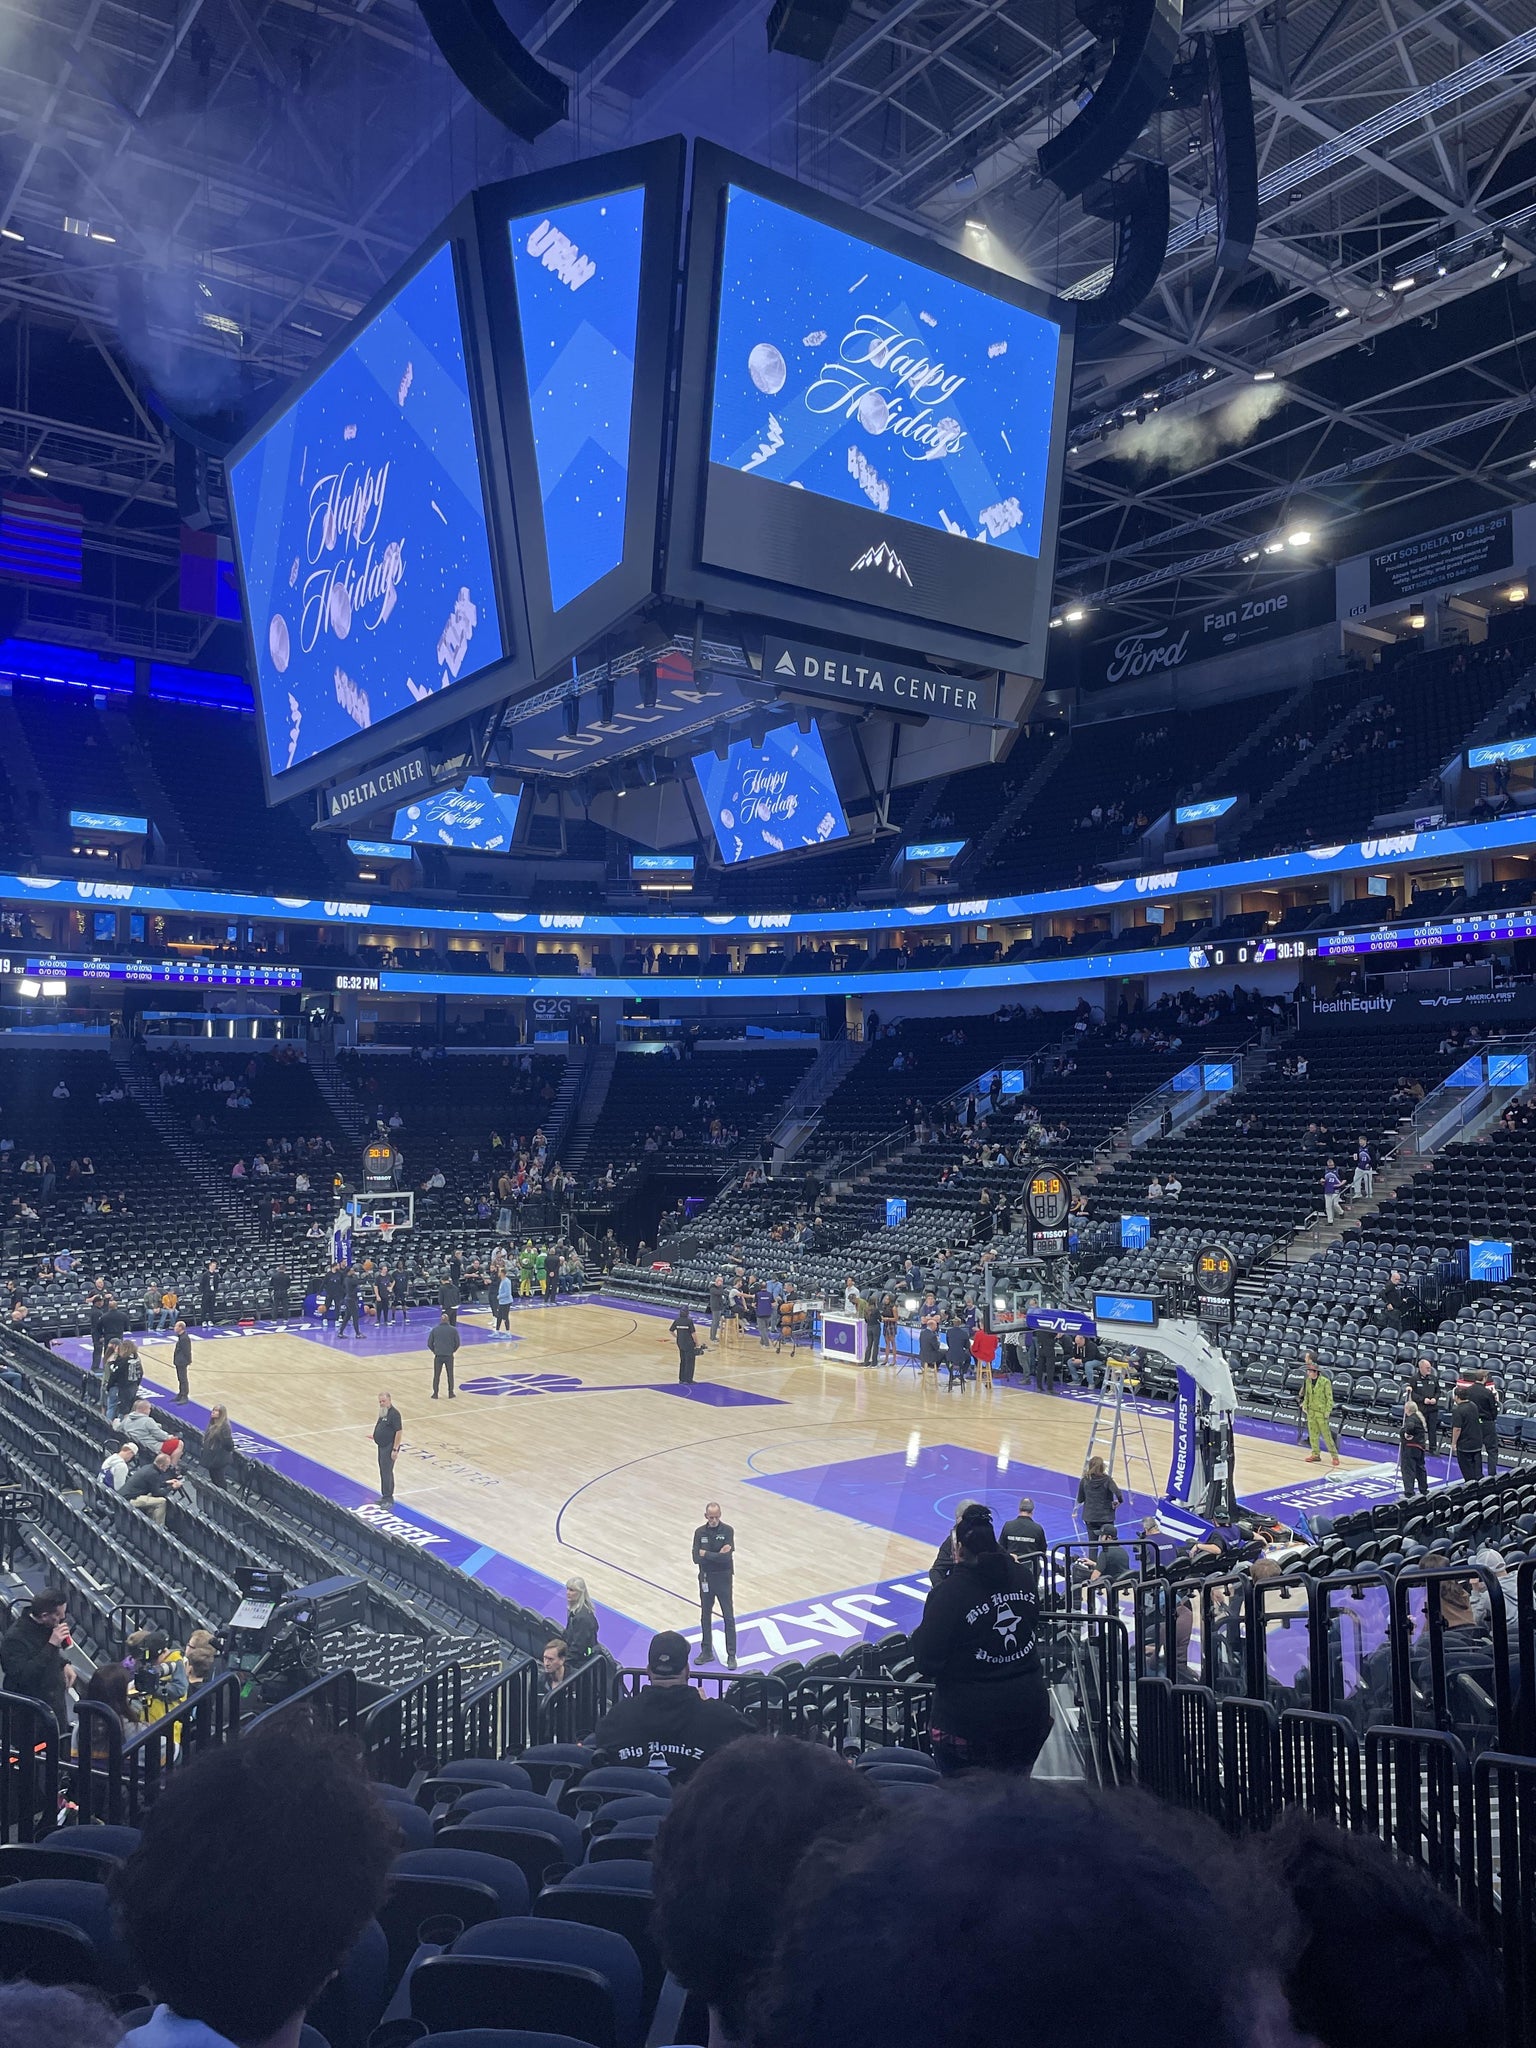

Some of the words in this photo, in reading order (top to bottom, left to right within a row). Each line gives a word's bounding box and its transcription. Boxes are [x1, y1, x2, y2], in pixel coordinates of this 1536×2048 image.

[840, 314, 966, 405] Happy
[805, 363, 968, 461] Hidays
[307, 461, 390, 564] Happy
[1375, 552, 1398, 566] TEXT
[1399, 545, 1418, 559] SOS
[1420, 535, 1449, 552] DELTA
[1451, 531, 1465, 542] TO
[300, 538, 406, 653] Hlidays
[1401, 584, 1416, 593] TEXT
[1203, 611, 1237, 633] Fan
[1241, 594, 1288, 622] Zone
[1106, 627, 1190, 682] Ford
[805, 656, 884, 692] DELTA
[893, 677, 978, 711] CENTER
[341, 780, 378, 810] DELTA
[378, 760, 424, 793] CENTER
[742, 768, 788, 796] Happy
[438, 792, 485, 812] Happy
[740, 794, 798, 824] Hidays
[425, 806, 485, 830] Hidays
[1427, 926, 1442, 935] (0%)
[1427, 936, 1442, 945] (0%)
[1216, 949, 1224, 965] 0
[1239, 947, 1247, 963] 0
[1278, 941, 1304, 959] 30:19
[1306, 948, 1317, 956] 1ST
[336, 975, 361, 989] 06:32
[363, 977, 378, 990] PM
[533, 998, 571, 1013] G2G
[1312, 997, 1394, 1014] HealthEquity
[1465, 993, 1495, 1001] AMERICA
[369, 1148, 390, 1158] 30:19
[1032, 1179, 1060, 1194] 30:19
[1043, 1230, 1068, 1239] TISSOT
[1202, 1257, 1230, 1273] 30:19
[1207, 1297, 1231, 1305] TISSOT
[214, 1323, 322, 1340] JAZZ
[1179, 1394, 1188, 1433] FIRST
[400, 1443, 435, 1460] ELTA
[1173, 1434, 1189, 1492] AMERICA
[1280, 1482, 1389, 1509] HEALTH
[349, 1503, 451, 1547] SEATGEEK
[966, 1602, 989, 1626] Big
[683, 1594, 898, 1668] JAZZ
[618, 1746, 644, 1761] Big
